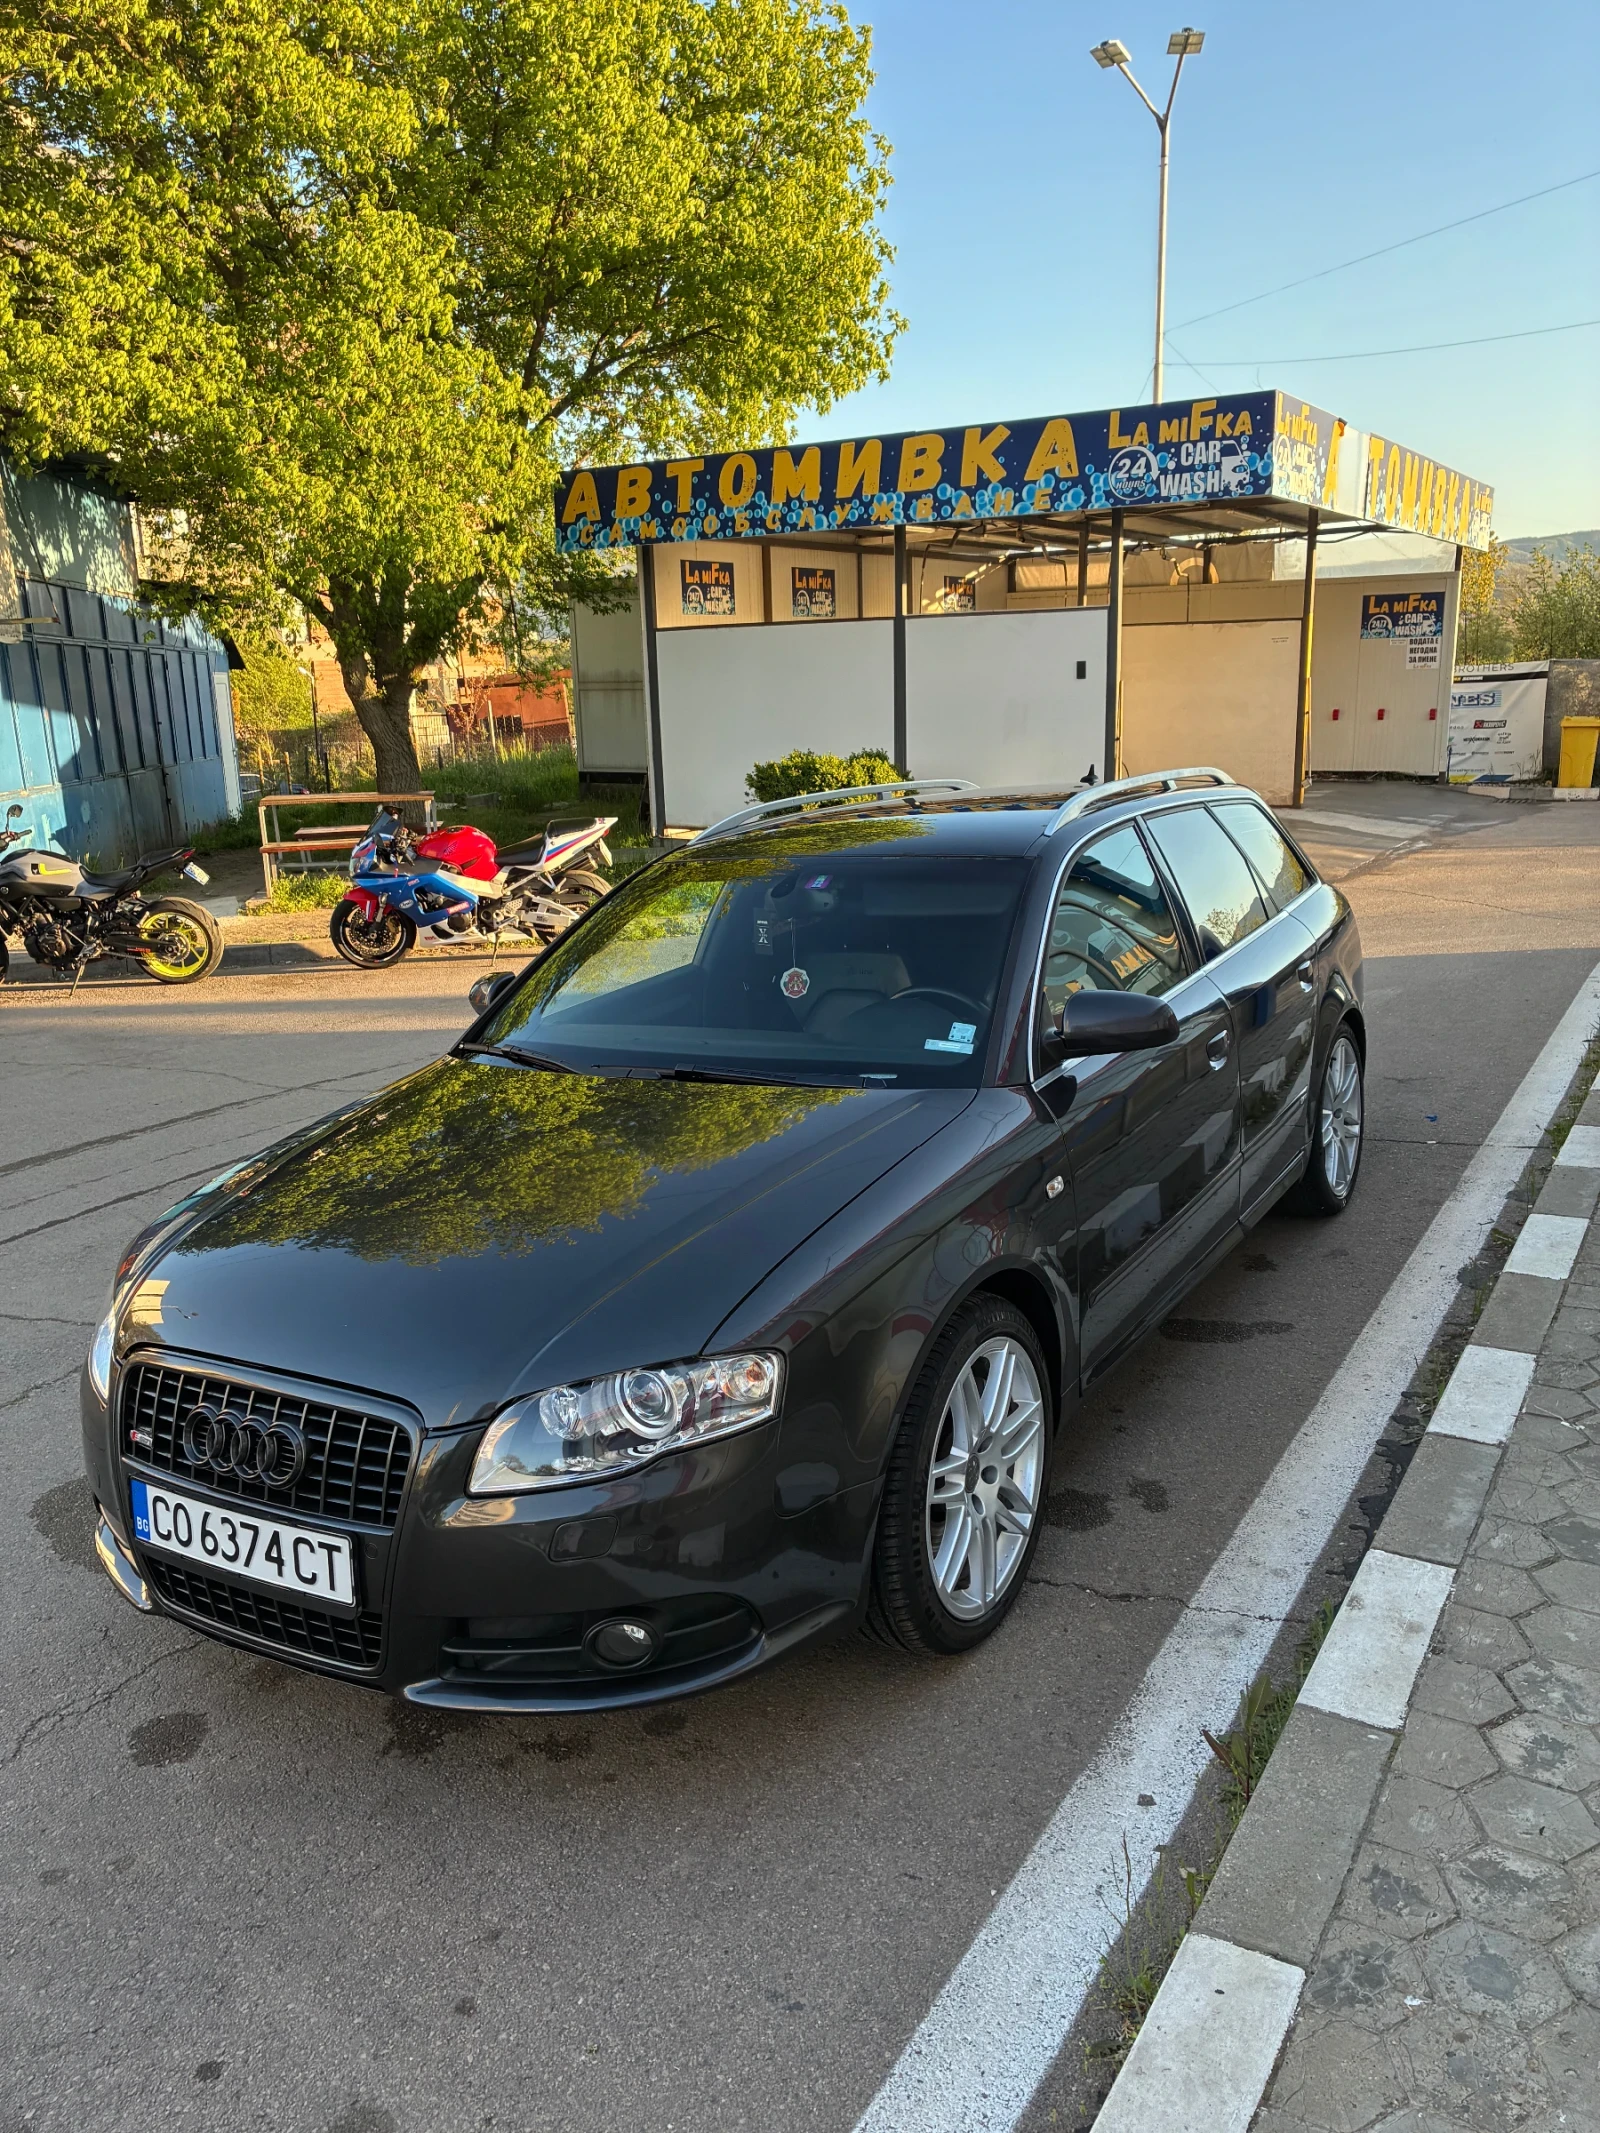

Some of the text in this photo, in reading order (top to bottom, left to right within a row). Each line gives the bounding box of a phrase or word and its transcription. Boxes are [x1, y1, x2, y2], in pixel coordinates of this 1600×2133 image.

[1181, 440, 1221, 466] CAR
[562, 418, 1079, 523] АВТОМИВКА
[1116, 457, 1147, 479] 24
[1116, 479, 1146, 489] HOURS
[1160, 470, 1220, 497] WASH
[580, 488, 1052, 545] САМООБСЛУЖВАНЕ
[1404, 613, 1424, 624] CAR
[1395, 625, 1422, 636] WASH
[1409, 637, 1435, 646] ВОДАТА
[1409, 646, 1438, 655] НЕГОДНА
[1408, 655, 1437, 664] ЗА ПИЕНЕ
[136, 1516, 149, 1532] BG
